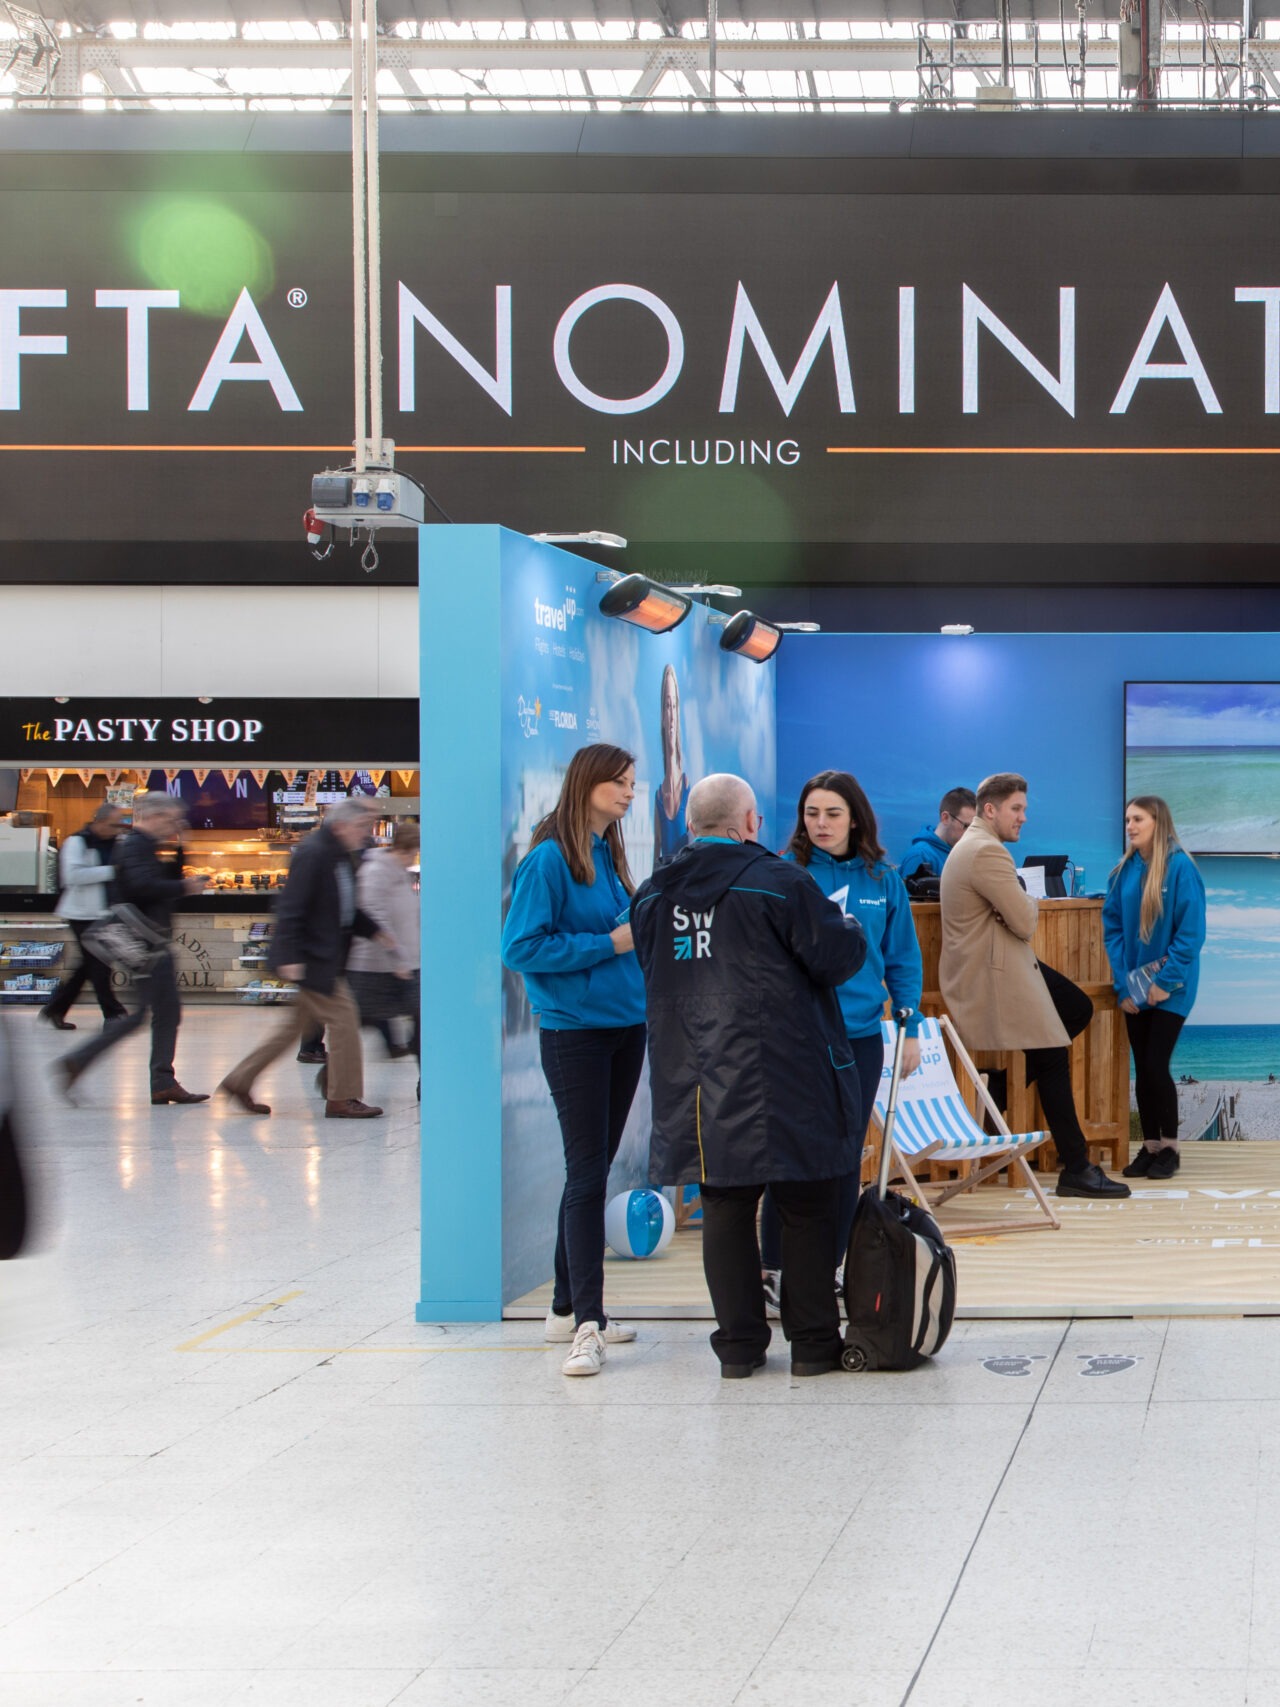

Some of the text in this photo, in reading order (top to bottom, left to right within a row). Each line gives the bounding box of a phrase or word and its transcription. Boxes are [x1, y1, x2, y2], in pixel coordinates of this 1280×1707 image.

[611, 438, 802, 466] INCLUDING
[535, 597, 567, 631] travel
[22, 718, 263, 742] The PASTY SHOP
[1003, 1202, 1153, 1211] Flights
[1135, 1238, 1206, 1246] VISIT
